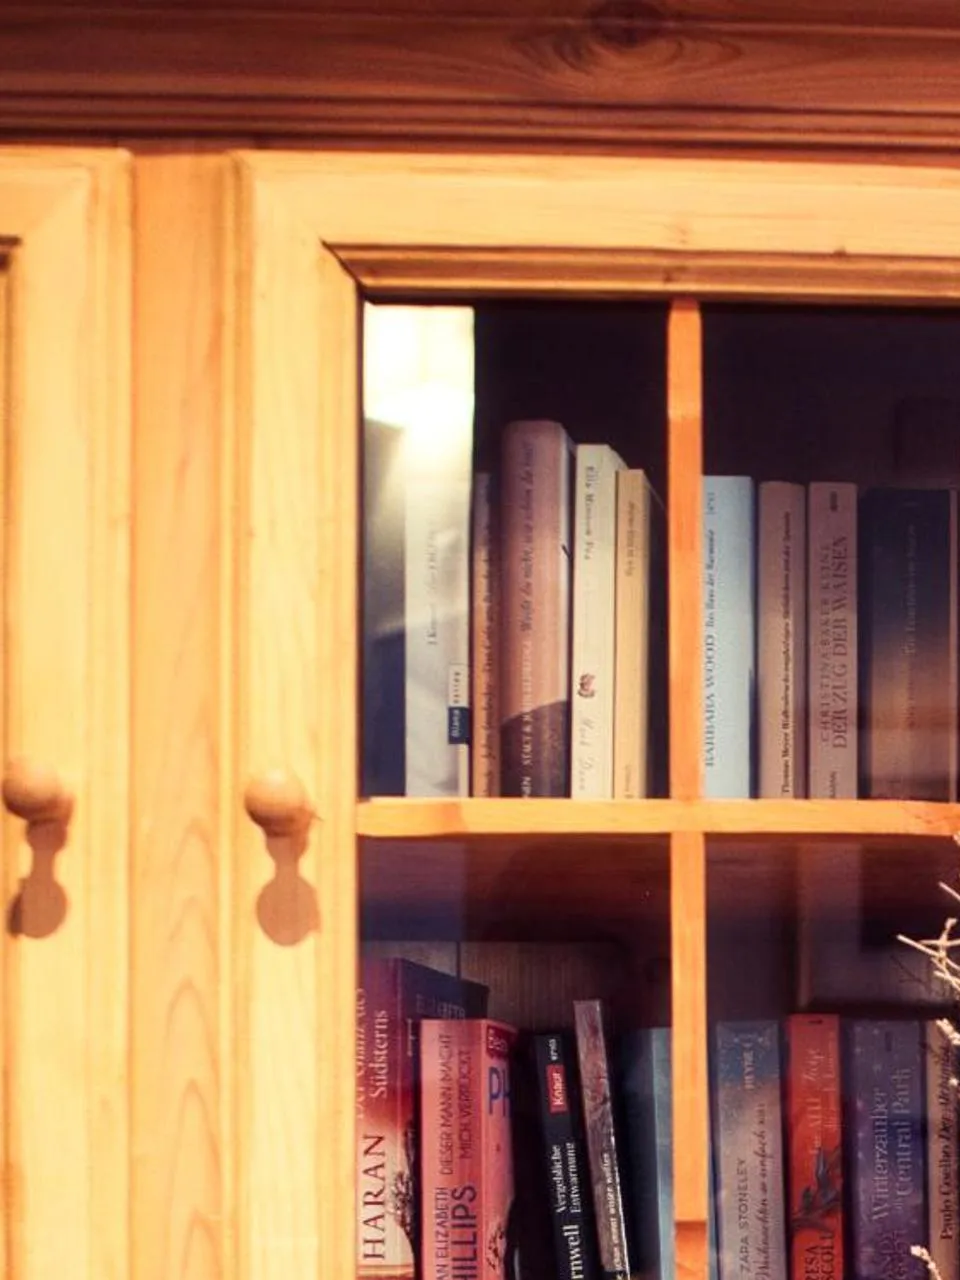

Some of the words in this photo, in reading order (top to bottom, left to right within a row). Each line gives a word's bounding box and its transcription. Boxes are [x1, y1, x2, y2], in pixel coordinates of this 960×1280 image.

[831, 535, 848, 612] WAISEN
[831, 617, 848, 657] DER
[831, 663, 848, 704] ZUG
[831, 708, 848, 749] DER
[367, 1009, 389, 1099] Südsterns
[438, 1086, 453, 1128] MANN
[870, 1087, 889, 1221] Winterzauber
[361, 1134, 386, 1262] HARAN
[435, 1186, 449, 1259] ELIZABETH
[737, 1157, 750, 1231] STONELEY
